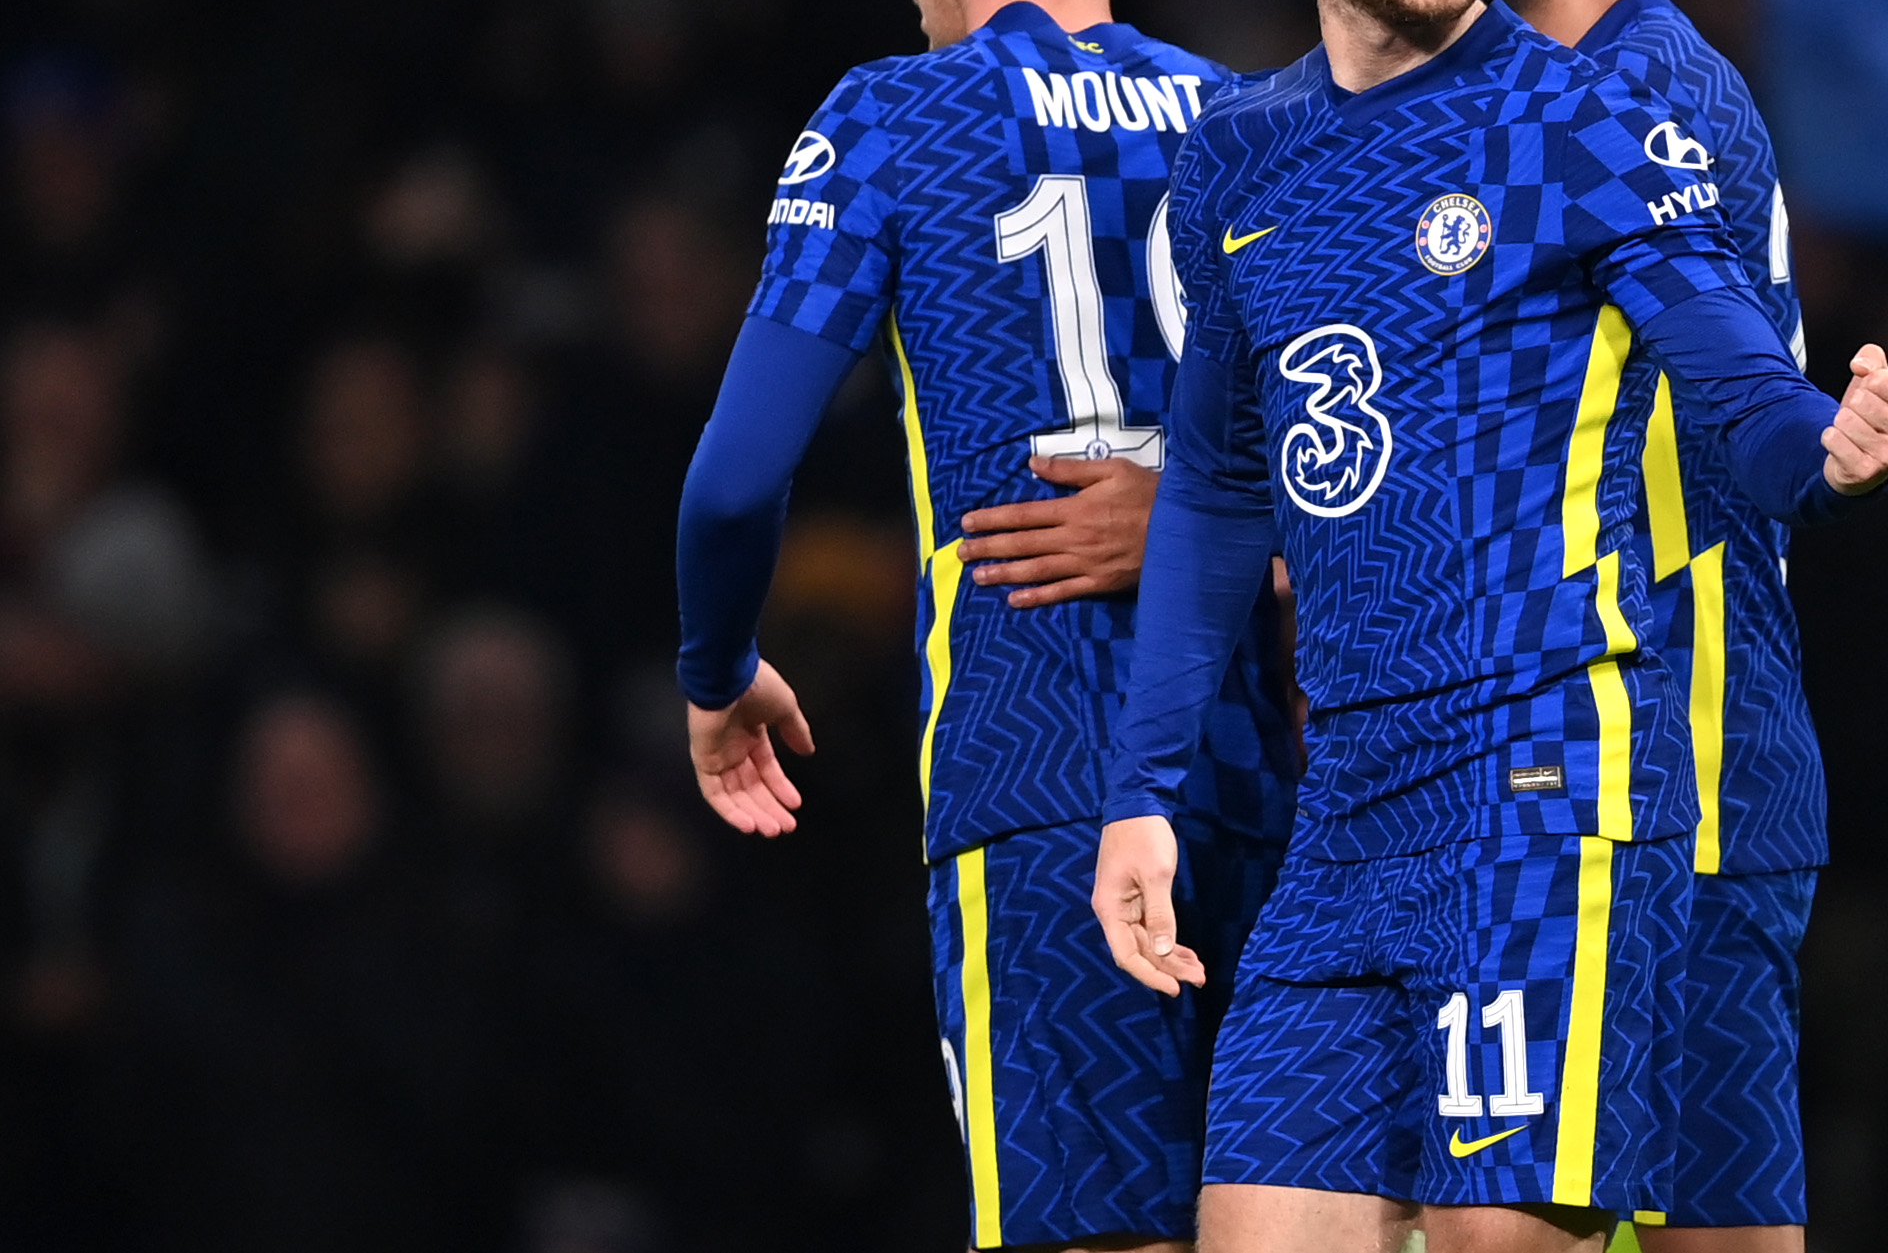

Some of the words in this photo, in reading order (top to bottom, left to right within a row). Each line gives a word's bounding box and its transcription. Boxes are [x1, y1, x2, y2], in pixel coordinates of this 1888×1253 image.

[1022, 67, 1202, 134] MOUNT
[767, 198, 835, 230] NDAI
[1433, 197, 1481, 217] CHELSEA
[1436, 989, 1544, 1117] 11
